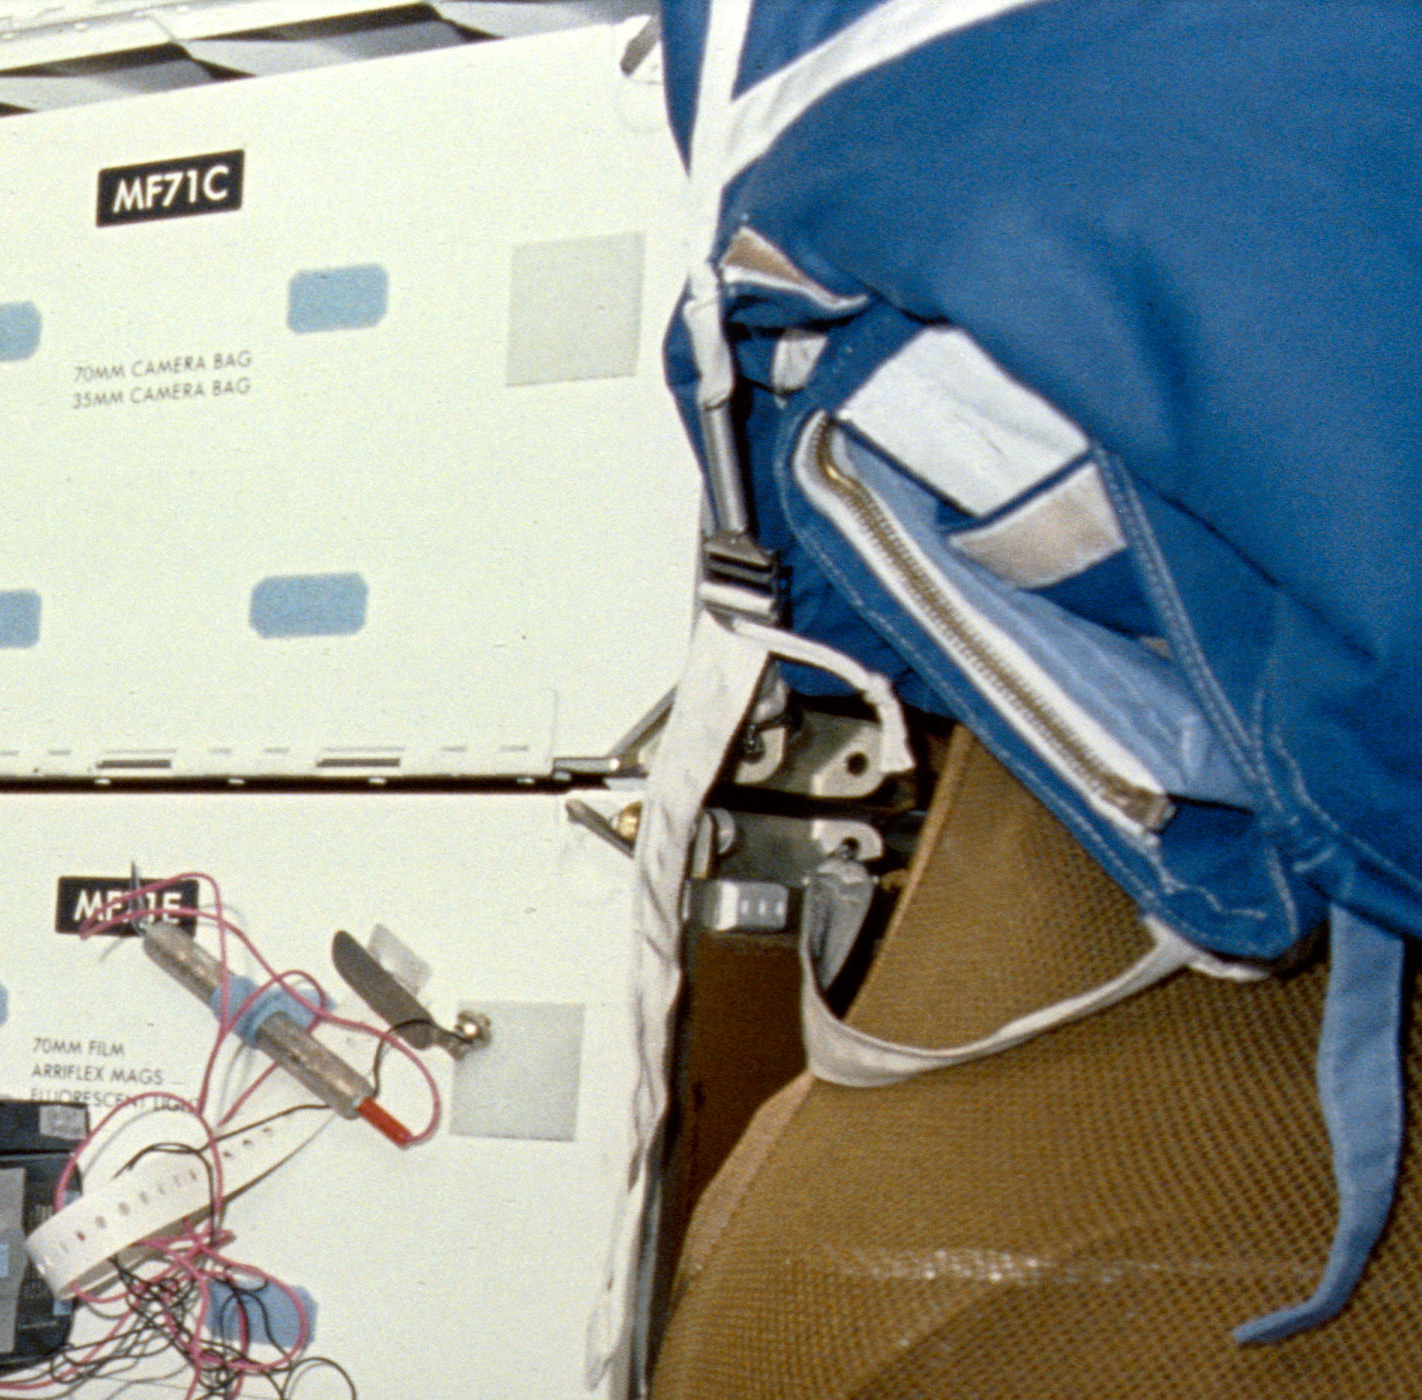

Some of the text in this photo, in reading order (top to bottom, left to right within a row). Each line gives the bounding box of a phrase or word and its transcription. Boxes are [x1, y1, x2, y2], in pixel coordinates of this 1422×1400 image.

[112, 164, 230, 213] MF71C
[74, 350, 252, 382] 70MM CAMERA BAG
[73, 377, 252, 409] 35MM CAMERA BAG
[33, 1038, 125, 1058] 70MM FILM
[31, 1063, 163, 1086] ARRIFLEX MAGS
